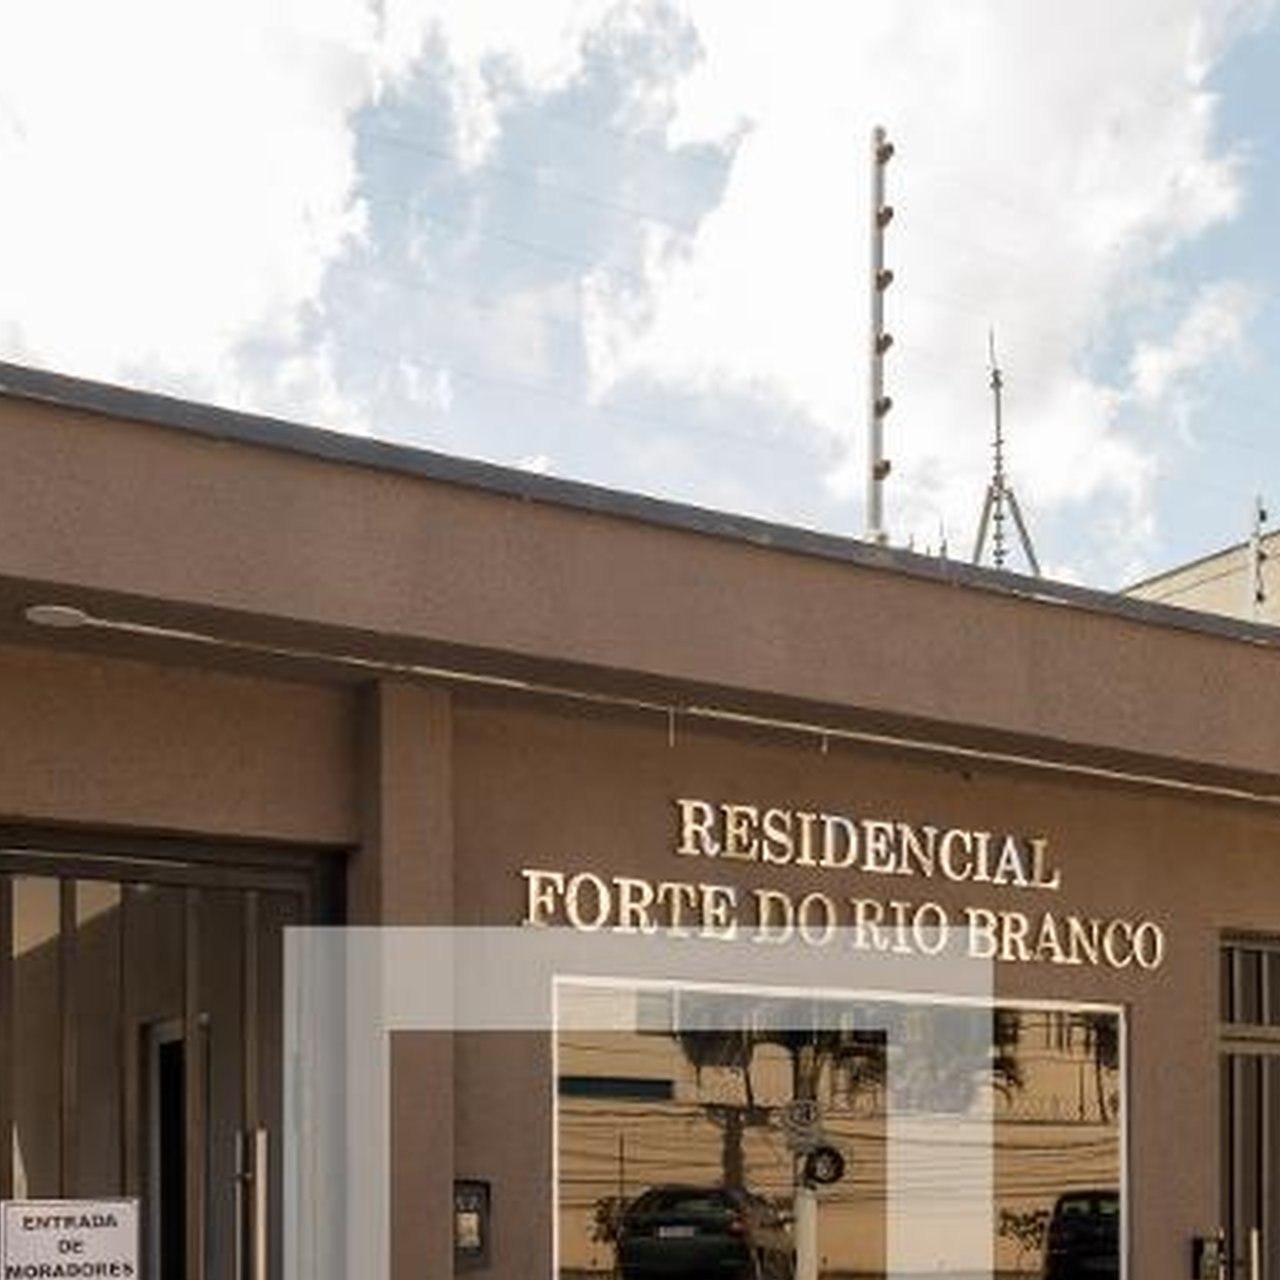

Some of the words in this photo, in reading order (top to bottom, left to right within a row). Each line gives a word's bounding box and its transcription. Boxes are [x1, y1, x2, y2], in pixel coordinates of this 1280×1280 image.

[677, 799, 1060, 889] RESIDENCIAL
[522, 869, 737, 940] FORTE
[751, 889, 836, 945] DO
[851, 898, 949, 954] RIO
[965, 908, 1164, 969] BRANCO
[22, 1214, 118, 1230] ENTRADA
[58, 1239, 84, 1254] DE
[5, 1262, 134, 1279] MORADORES
